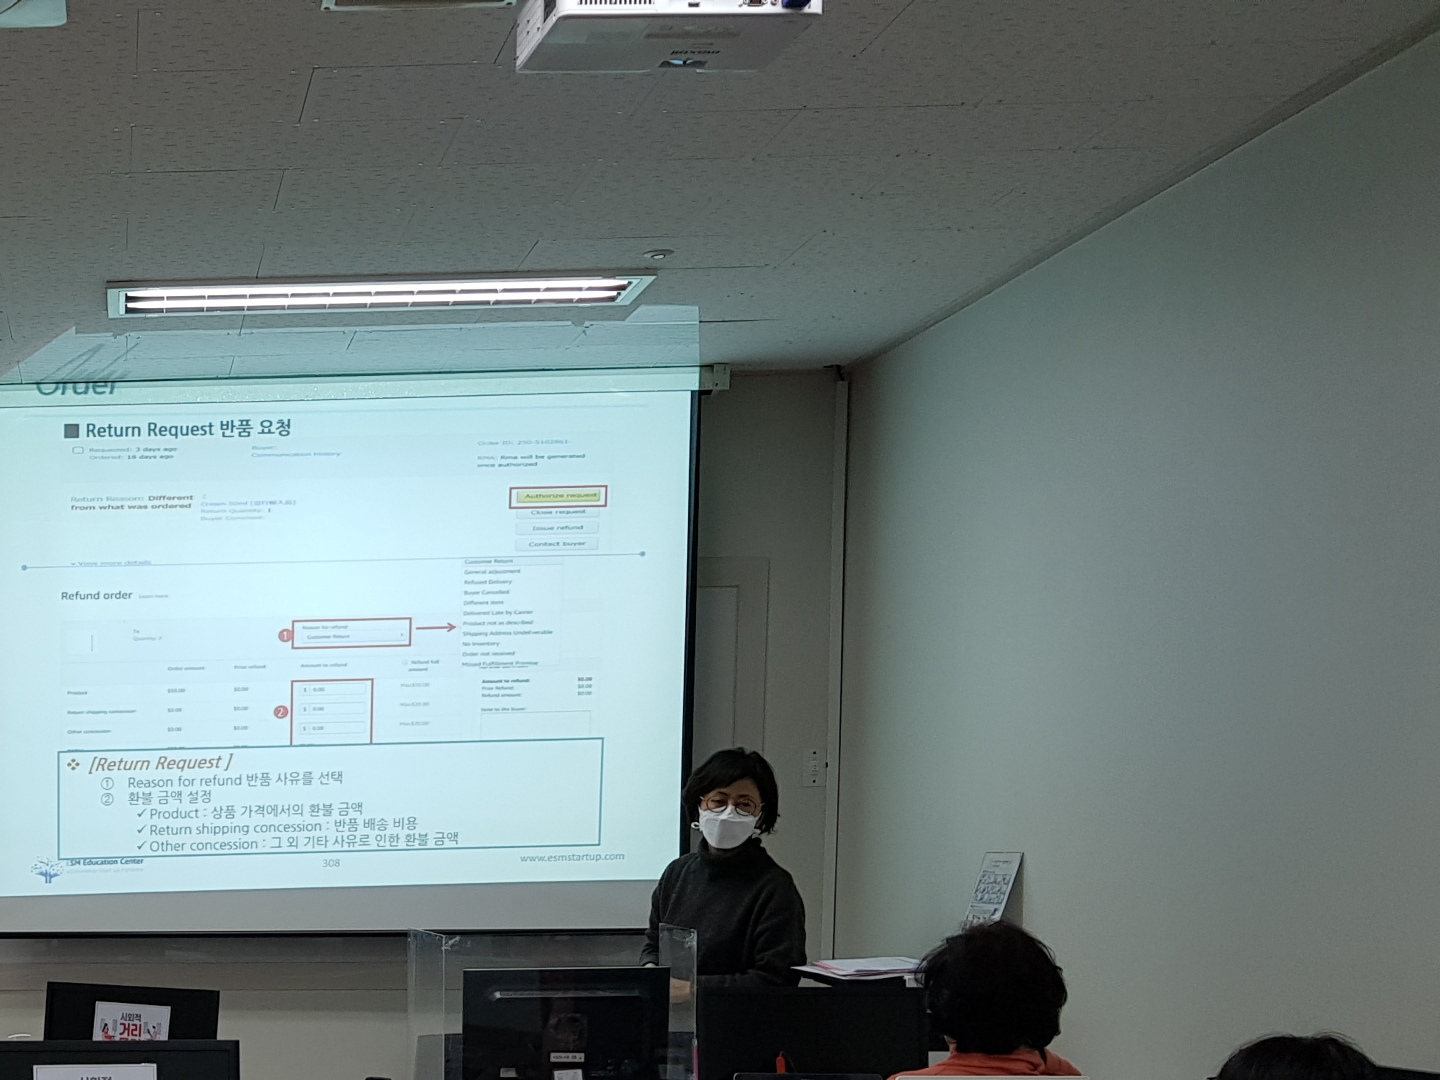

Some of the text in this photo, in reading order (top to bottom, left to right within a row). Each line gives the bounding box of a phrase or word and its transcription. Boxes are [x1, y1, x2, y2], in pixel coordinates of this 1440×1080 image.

[86, 419, 291, 439] Return Request 반품 요청
[567, 492, 598, 500] request
[61, 591, 133, 600] Refund order
[89, 757, 151, 774] [Return
[155, 755, 222, 772] Request
[128, 776, 173, 789] Reason
[178, 775, 196, 788] for
[199, 774, 242, 787] refund
[246, 773, 271, 787] 반품
[275, 772, 314, 786] 사유를
[318, 771, 343, 785] 선택
[127, 791, 153, 806] 환불
[157, 790, 183, 804] 금액
[187, 790, 212, 803] 설정
[150, 801, 363, 820] Product 상품 가격에서의 환불 금액
[150, 816, 418, 836] Return shipping concession 반품 배송 비용
[150, 831, 459, 852] Other concession 그 외 기타 사유로 인한 환불 금액
[322, 859, 340, 868] 308
[520, 852, 625, 863] www.esmstartup.com
[120, 1012, 142, 1022] 사회적
[119, 1022, 142, 1038] 거리
